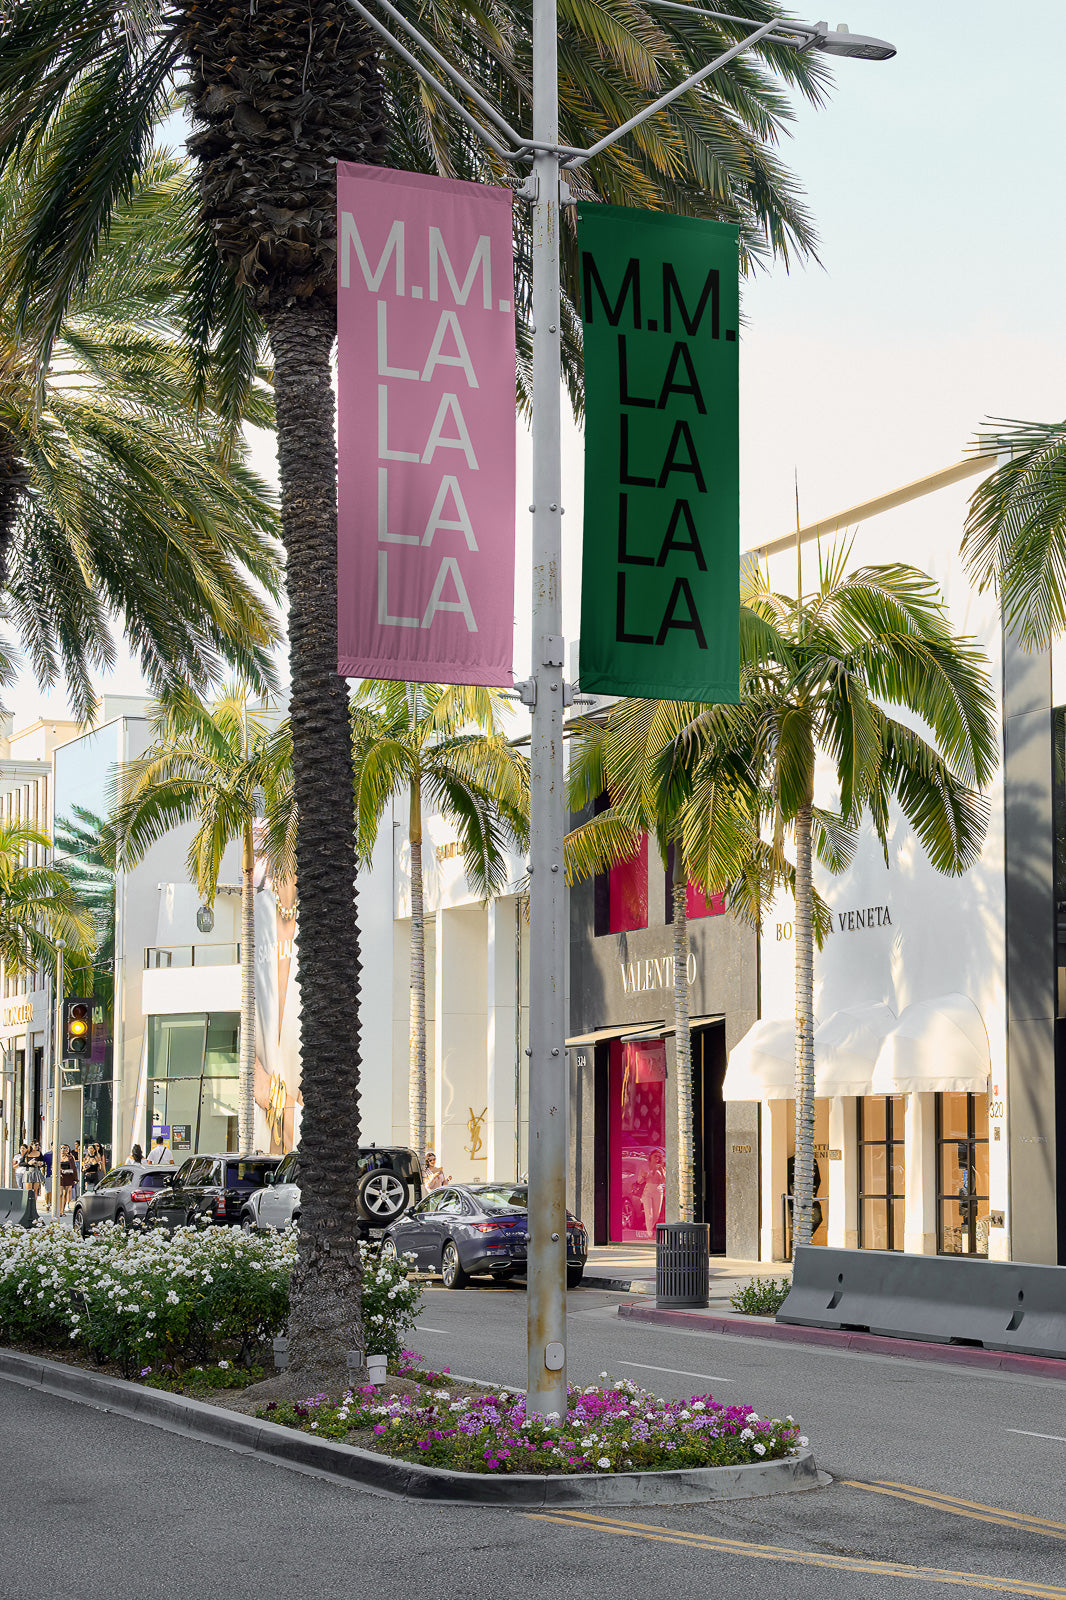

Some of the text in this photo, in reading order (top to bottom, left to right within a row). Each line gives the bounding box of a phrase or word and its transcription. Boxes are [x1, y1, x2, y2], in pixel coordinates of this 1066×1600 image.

[340, 211, 511, 313] M.M.
[582, 251, 737, 342] M.M.
[377, 300, 480, 389] LA
[616, 333, 708, 415] LA
[377, 384, 480, 471] LA
[616, 412, 708, 494] LA
[377, 467, 480, 552] LA
[616, 492, 708, 572] LA
[377, 550, 480, 633] LA
[616, 571, 708, 650] LA
[838, 905, 893, 931] VENETA
[620, 952, 697, 993] VALENTIO
[989, 1101, 1004, 1119] 320
